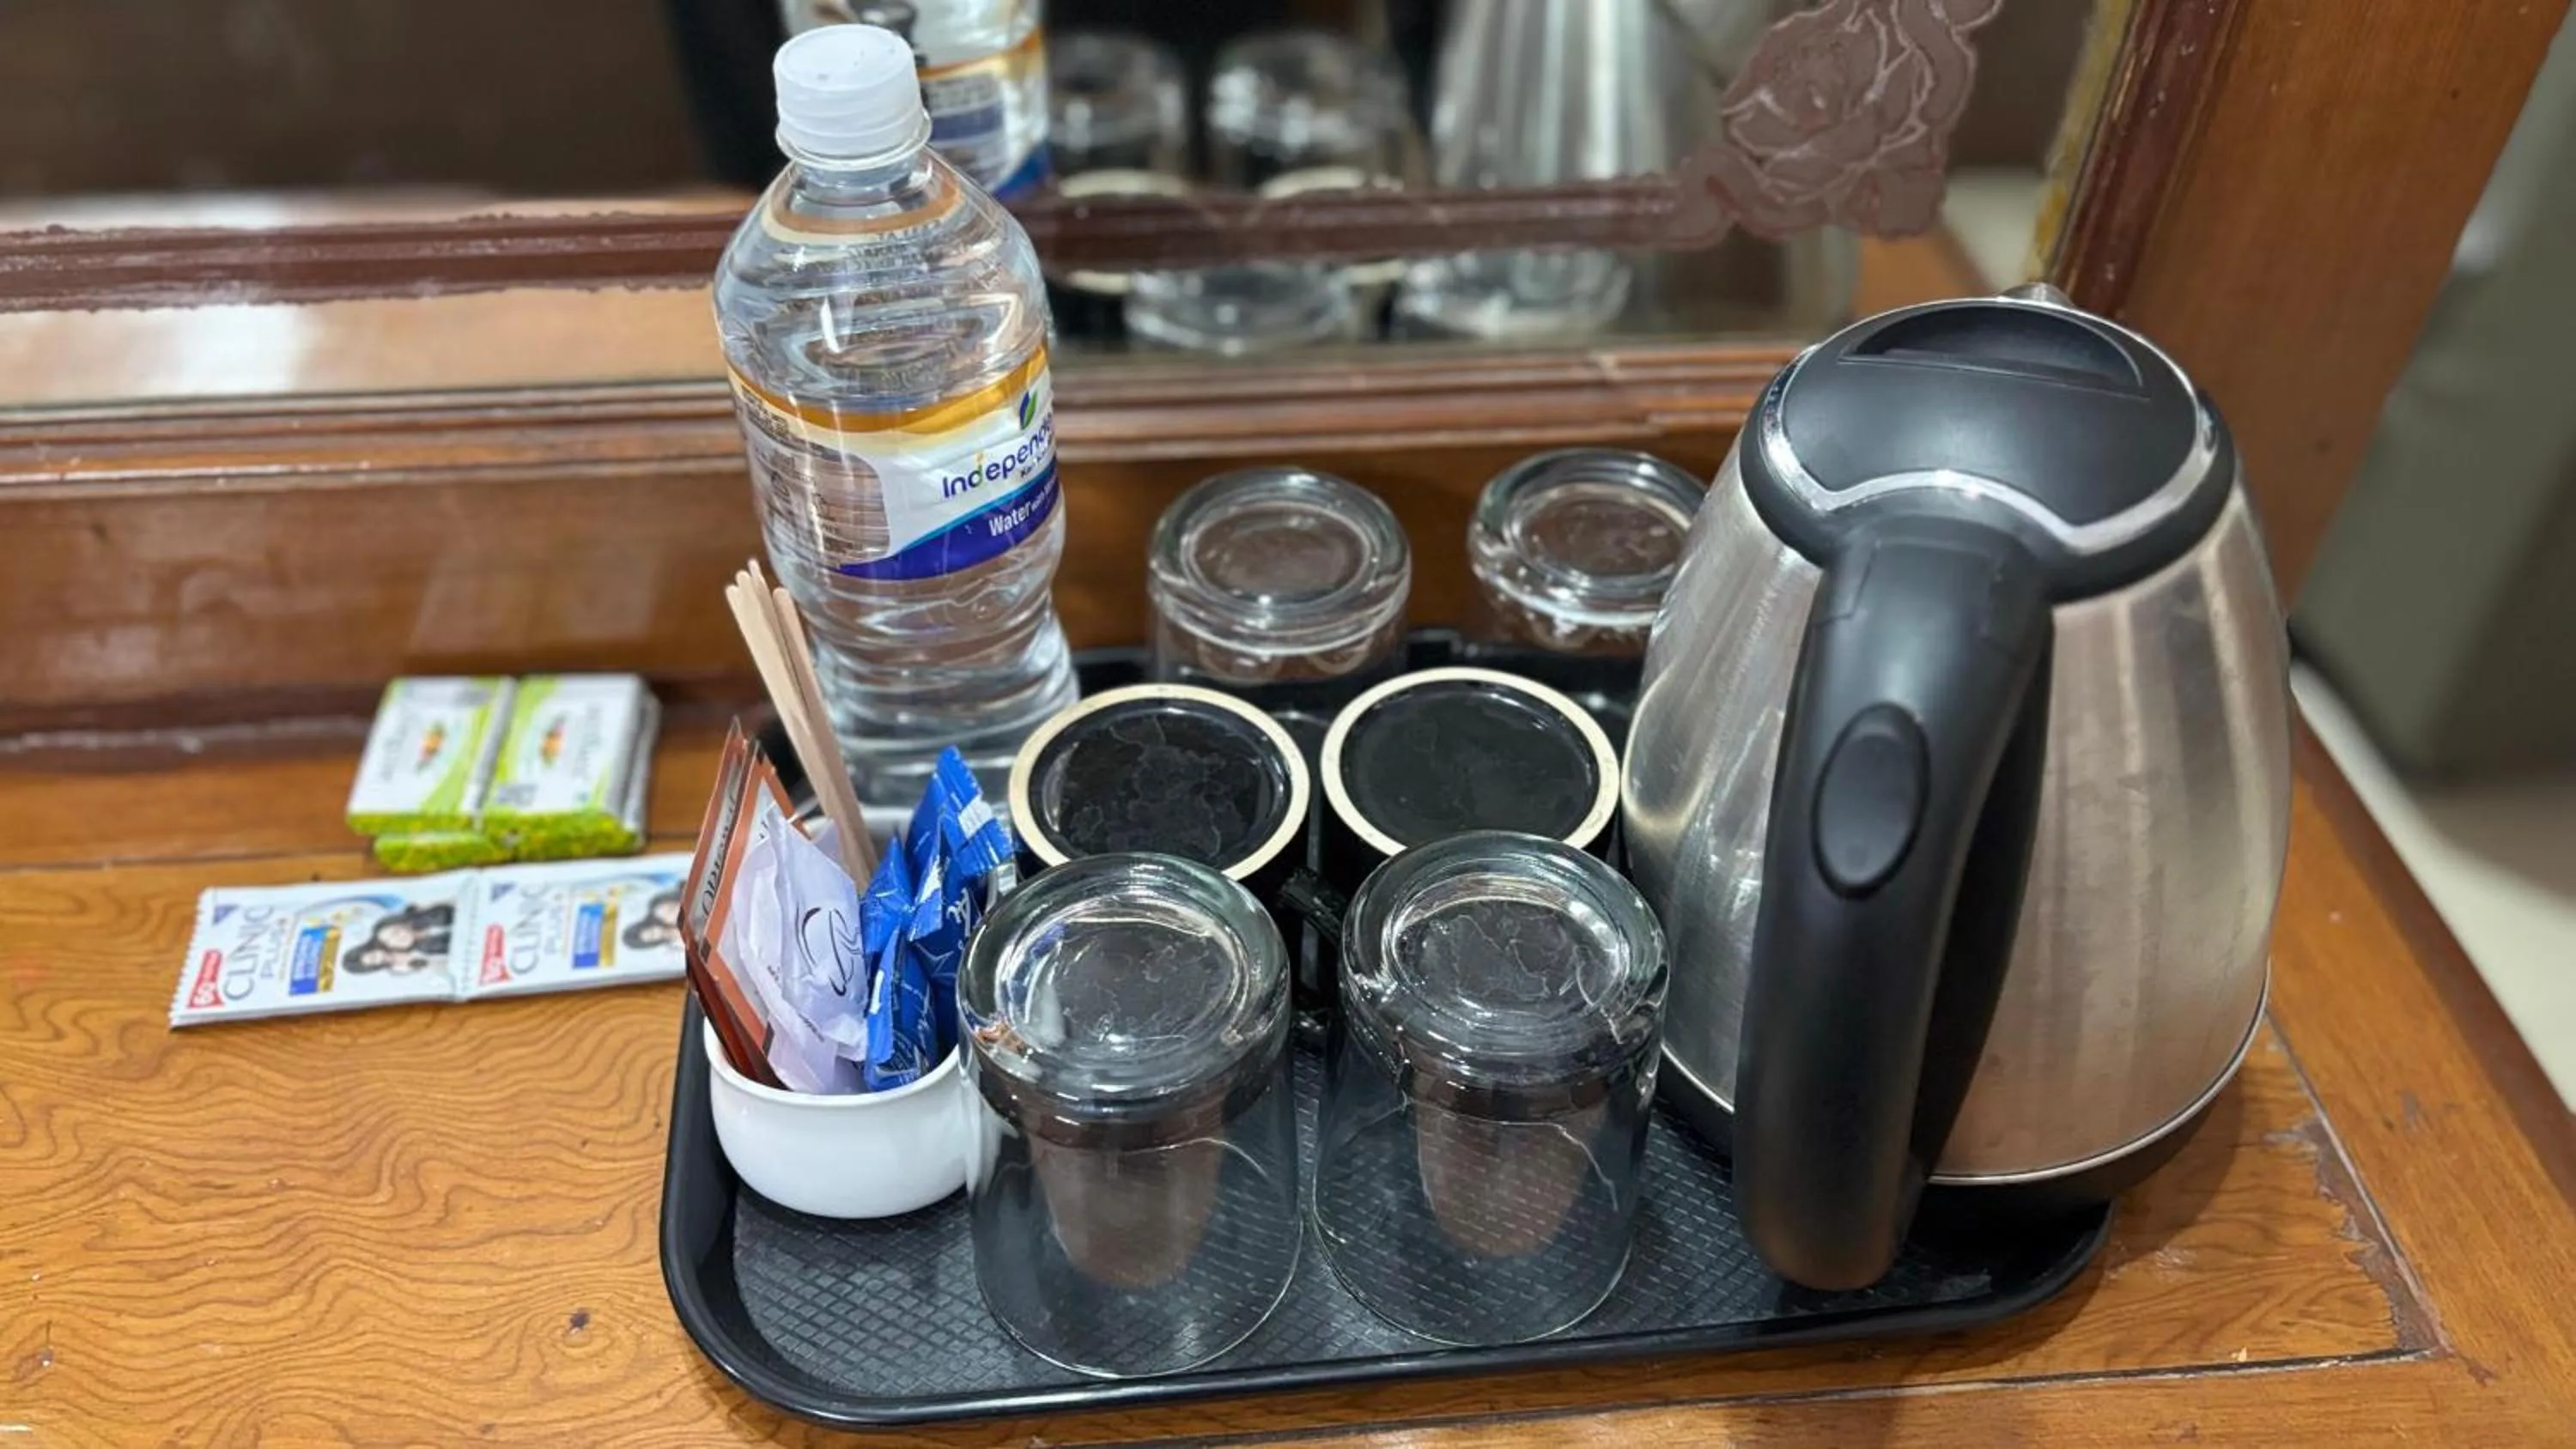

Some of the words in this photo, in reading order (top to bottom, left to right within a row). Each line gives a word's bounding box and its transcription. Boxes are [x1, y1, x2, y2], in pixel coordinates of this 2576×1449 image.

[988, 501, 1031, 537] Water
[222, 905, 275, 1002] CLINIC
[510, 881, 552, 976] CLINIC
